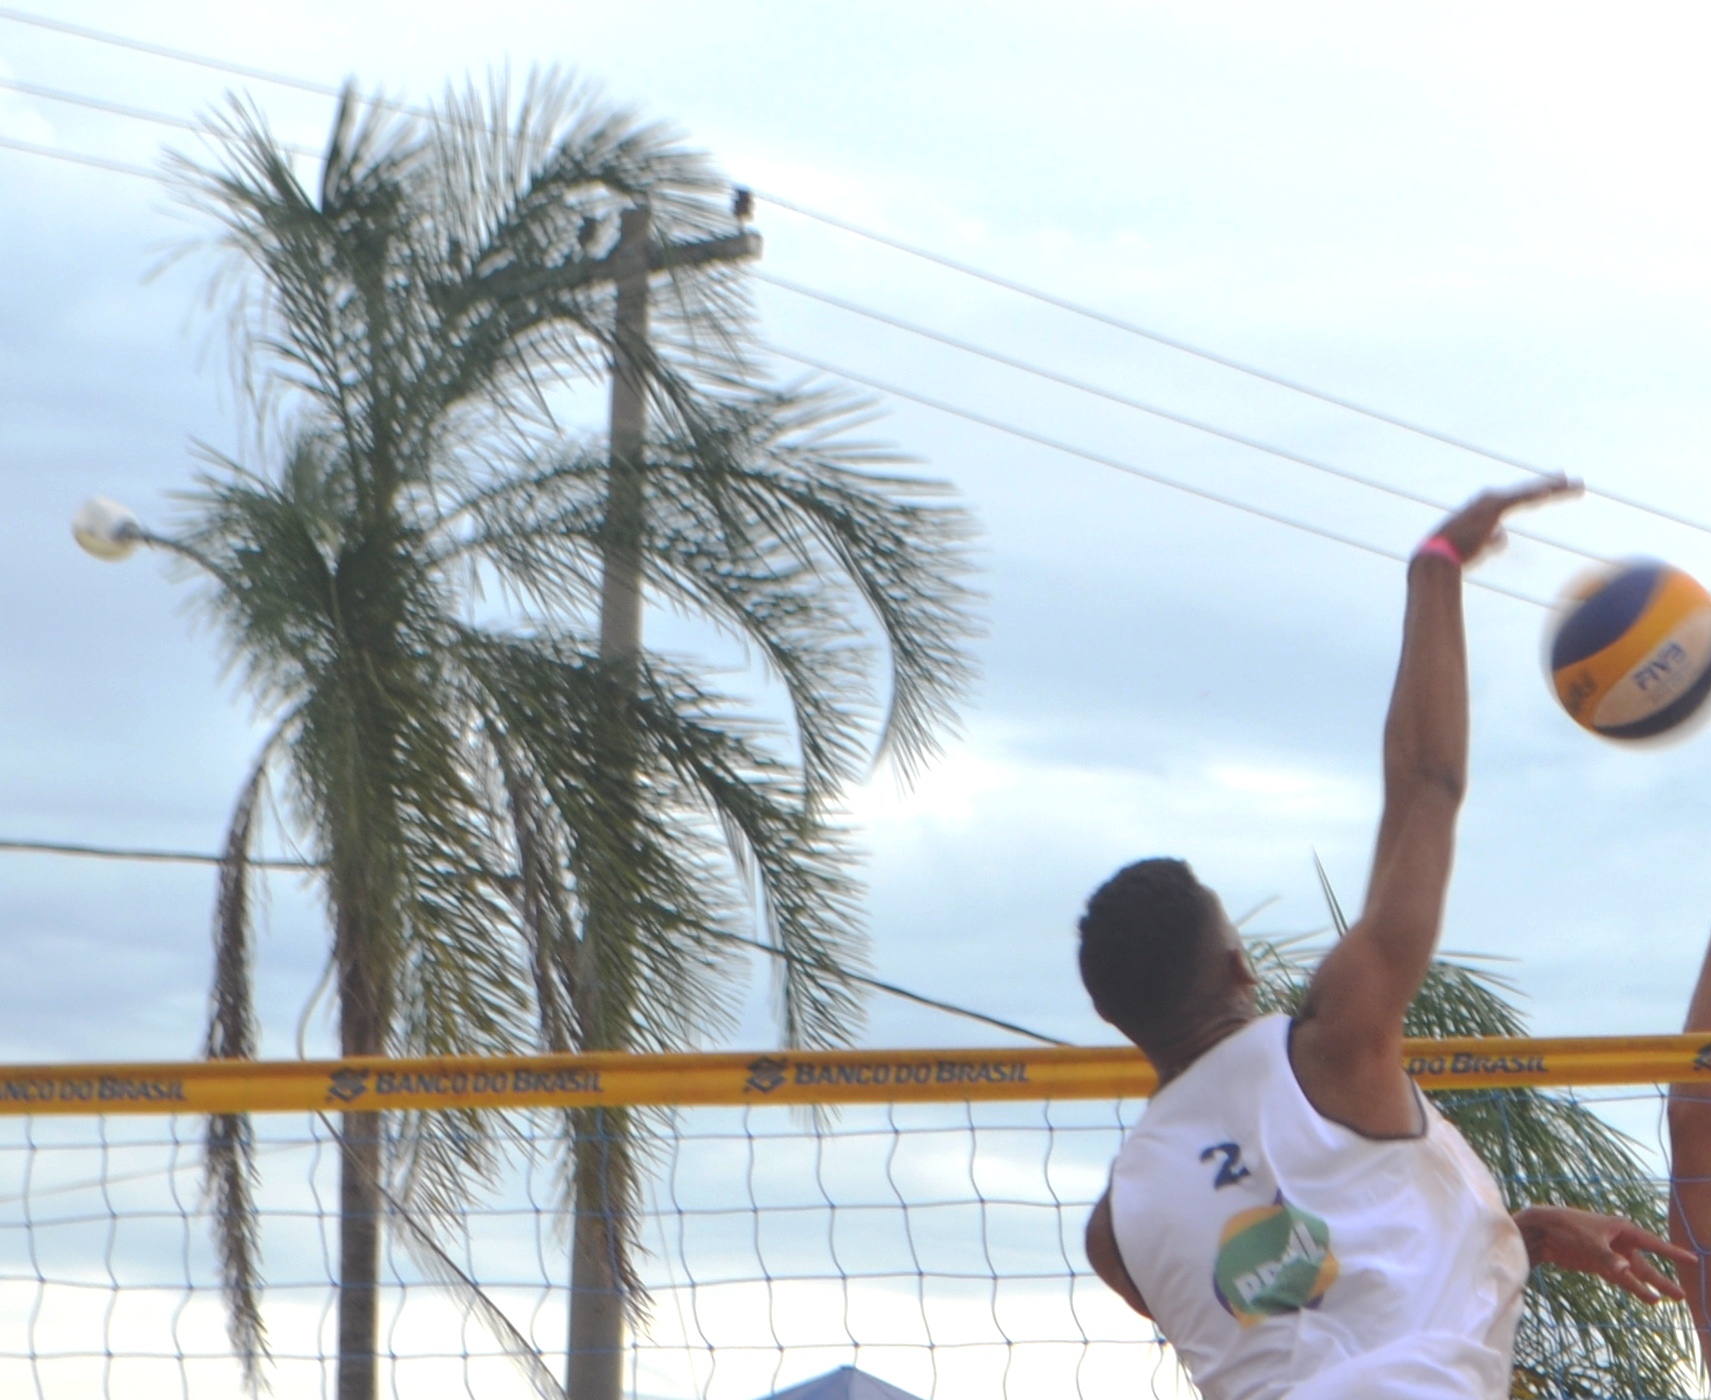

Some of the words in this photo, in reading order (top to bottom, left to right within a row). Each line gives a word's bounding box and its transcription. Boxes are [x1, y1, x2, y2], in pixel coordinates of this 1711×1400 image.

[375, 1069, 470, 1094] BANCO
[512, 1066, 603, 1093] BRASIL
[794, 1061, 890, 1086] BANCO
[936, 1059, 1029, 1083] BRASIL
[98, 1074, 187, 1102] BRASIL
[1200, 1142, 1251, 1192] 2
